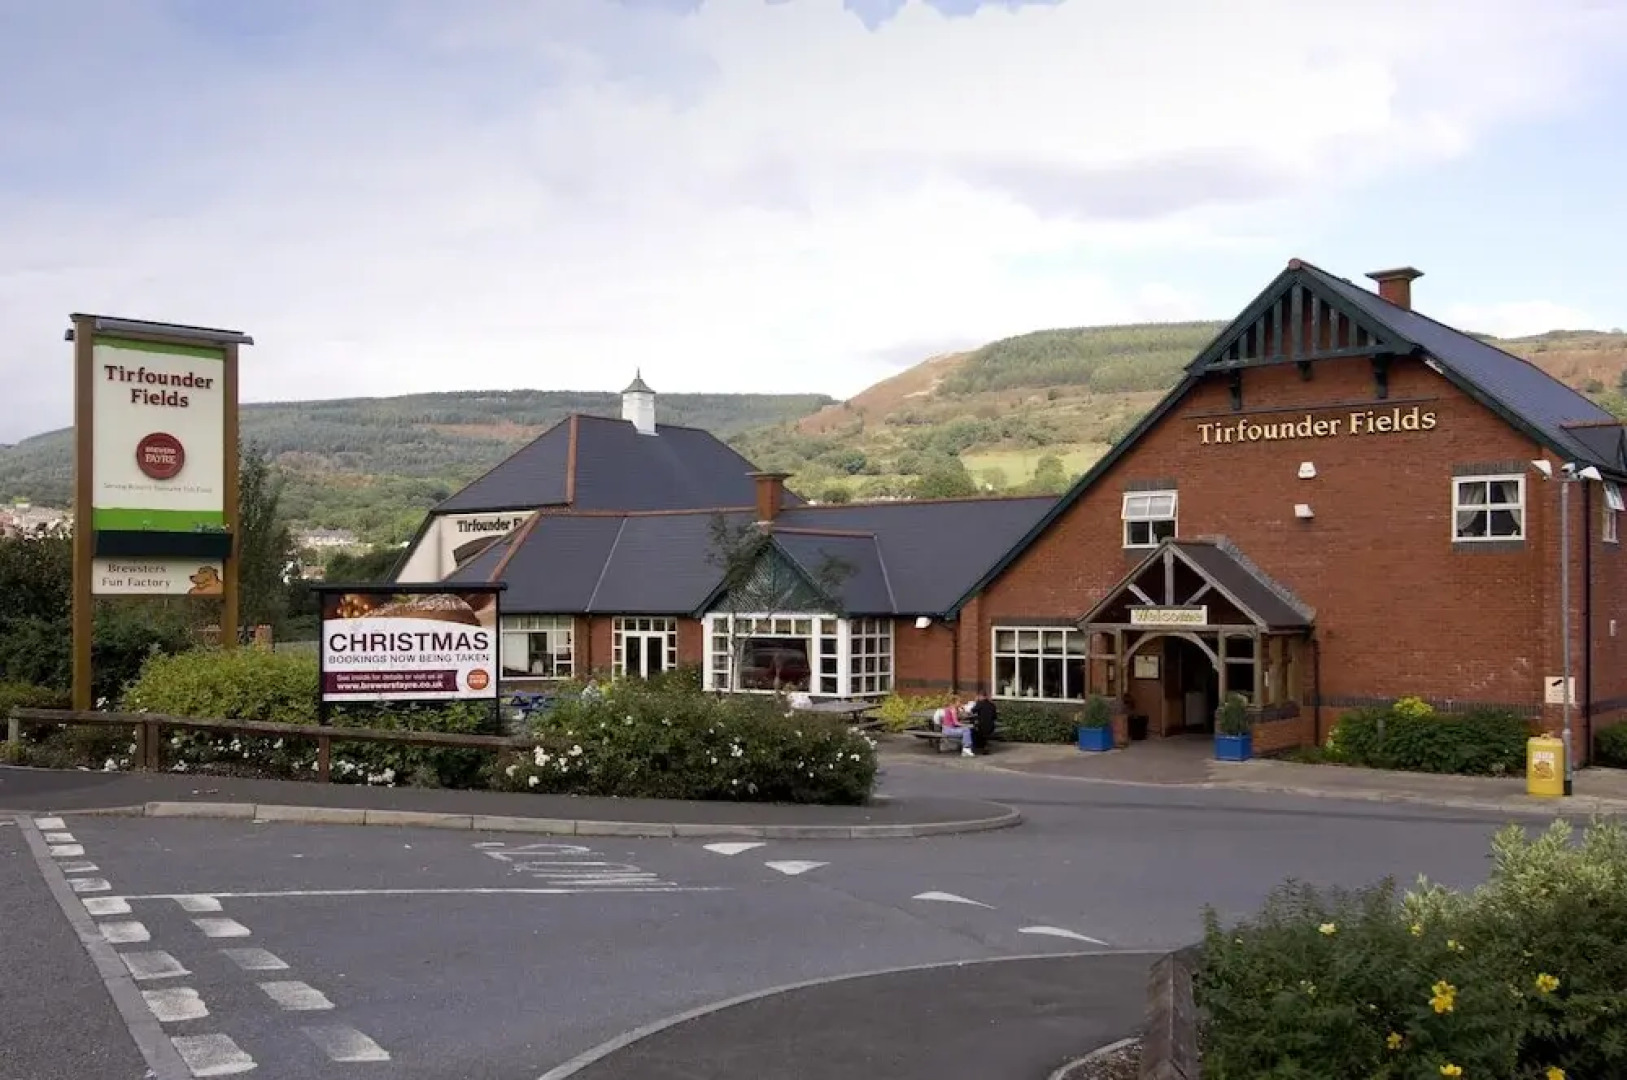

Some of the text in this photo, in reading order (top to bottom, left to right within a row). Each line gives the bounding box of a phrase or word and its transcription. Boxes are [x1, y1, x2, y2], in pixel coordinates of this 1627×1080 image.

[104, 365, 213, 389] Tirfounder
[131, 388, 189, 407] Fields
[1197, 406, 1436, 445] Tirfounder Fields
[457, 517, 511, 532] Tirfounder
[108, 563, 167, 573] Brewsters
[102, 577, 171, 588] Fun Factory
[329, 632, 489, 652] CHRISTMAS
[328, 653, 490, 664] BOOKINGS NOW BEING TAKEN
